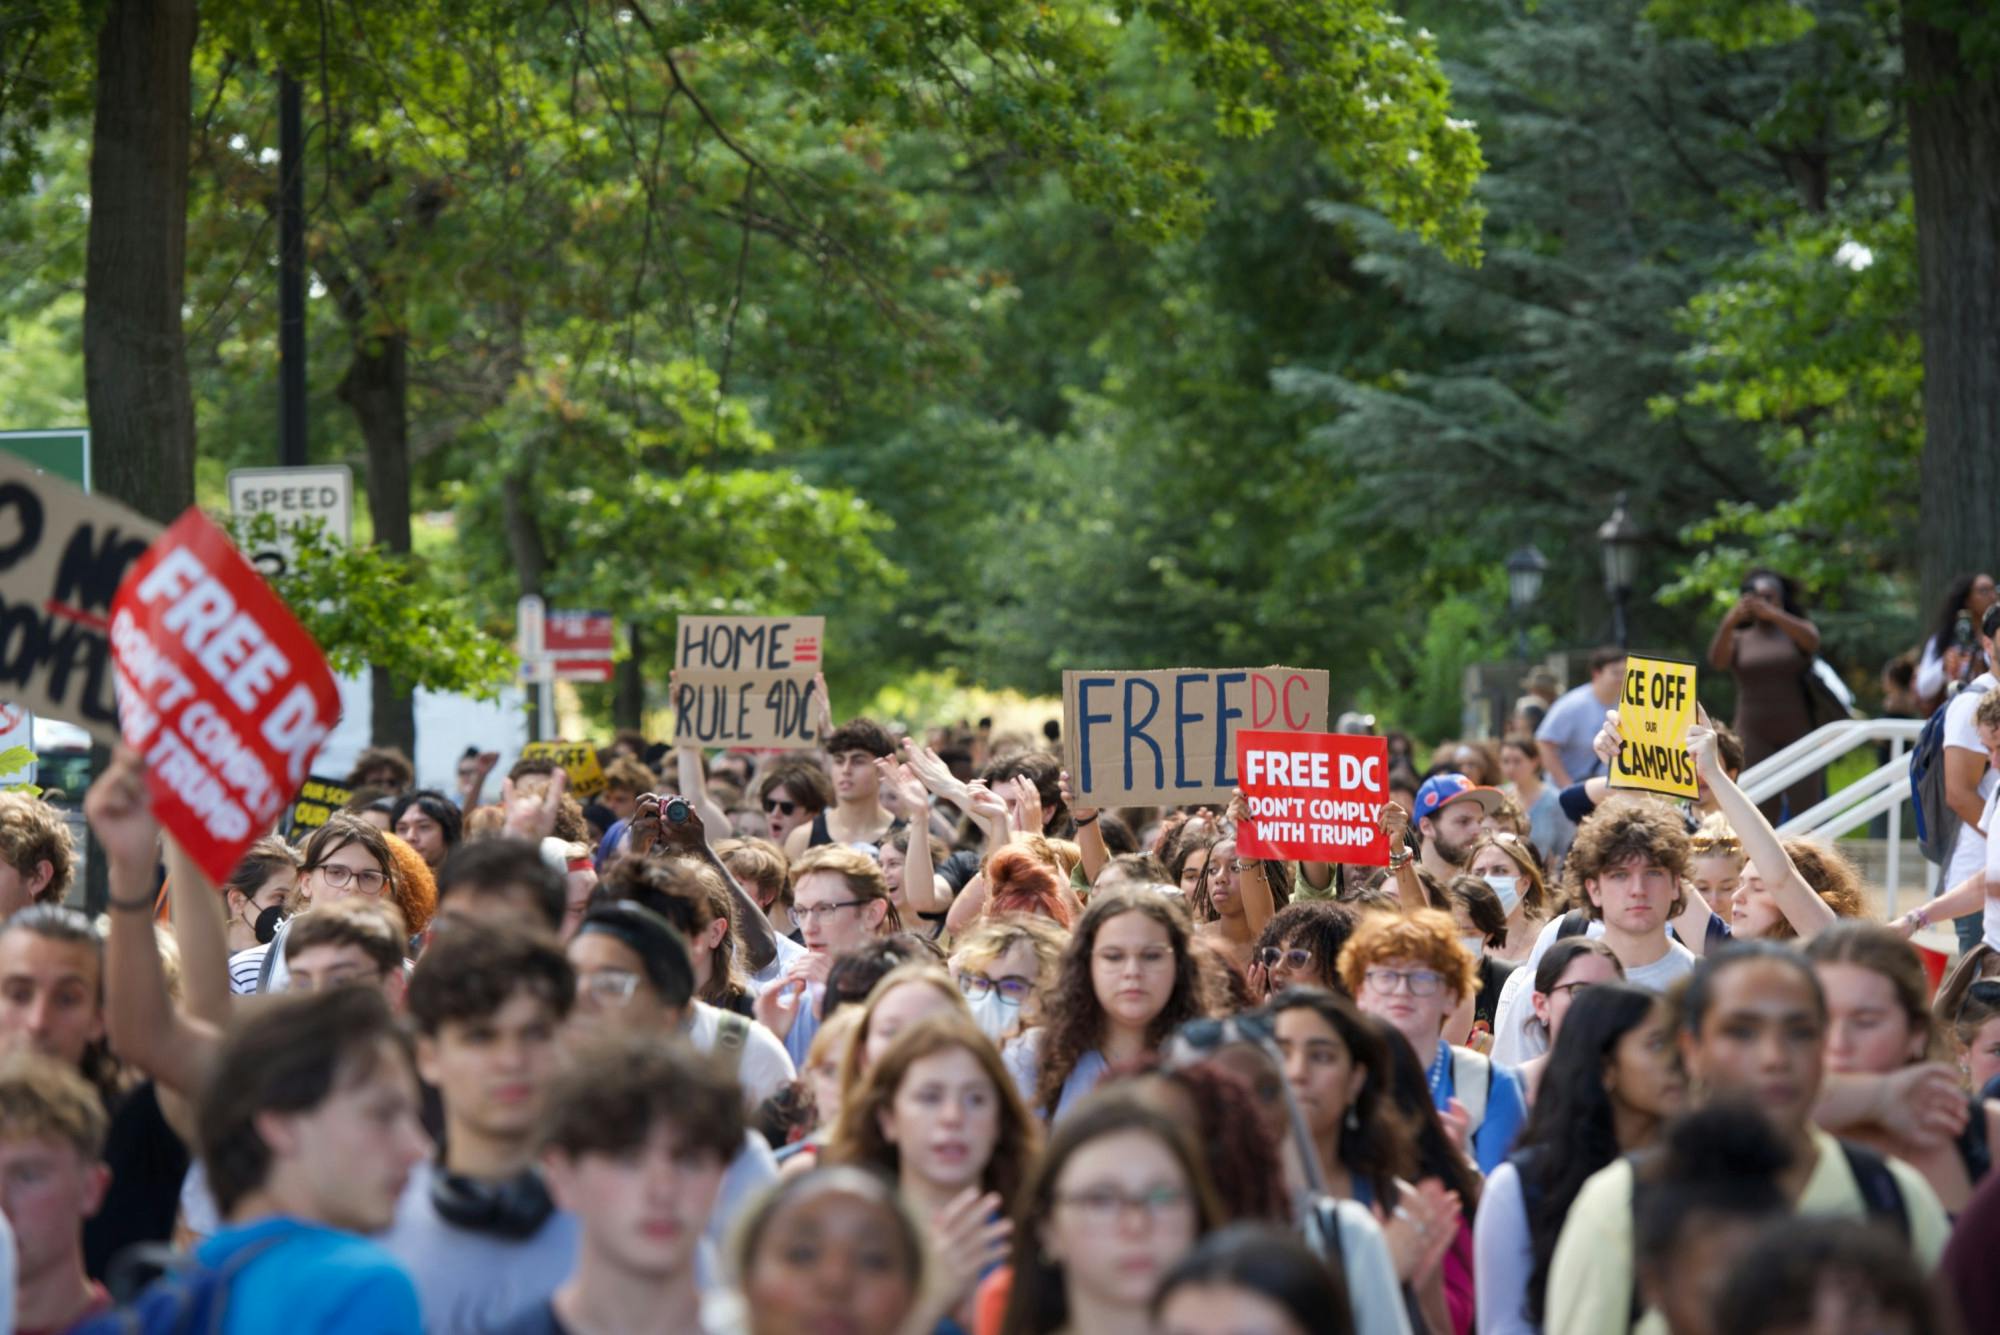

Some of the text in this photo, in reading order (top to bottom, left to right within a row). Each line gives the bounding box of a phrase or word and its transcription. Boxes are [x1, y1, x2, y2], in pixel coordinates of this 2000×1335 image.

[242, 486, 338, 512] SPEED
[137, 545, 292, 713] FREE
[260, 683, 330, 782] DC
[682, 623, 791, 671] HOME
[676, 678, 816, 741] RULE 4DC
[1651, 672, 1686, 712] OFF
[1079, 673, 1311, 793] FREE DC
[1645, 721, 1657, 733] OUR
[179, 699, 283, 822] COMPLY
[1246, 750, 1381, 792] FREE DC
[1617, 740, 1693, 786] CAMPUS
[145, 728, 251, 842] TRUMP
[1248, 796, 1381, 822] DON'T COMPLY
[1257, 820, 1374, 847] WITH TRUMP
